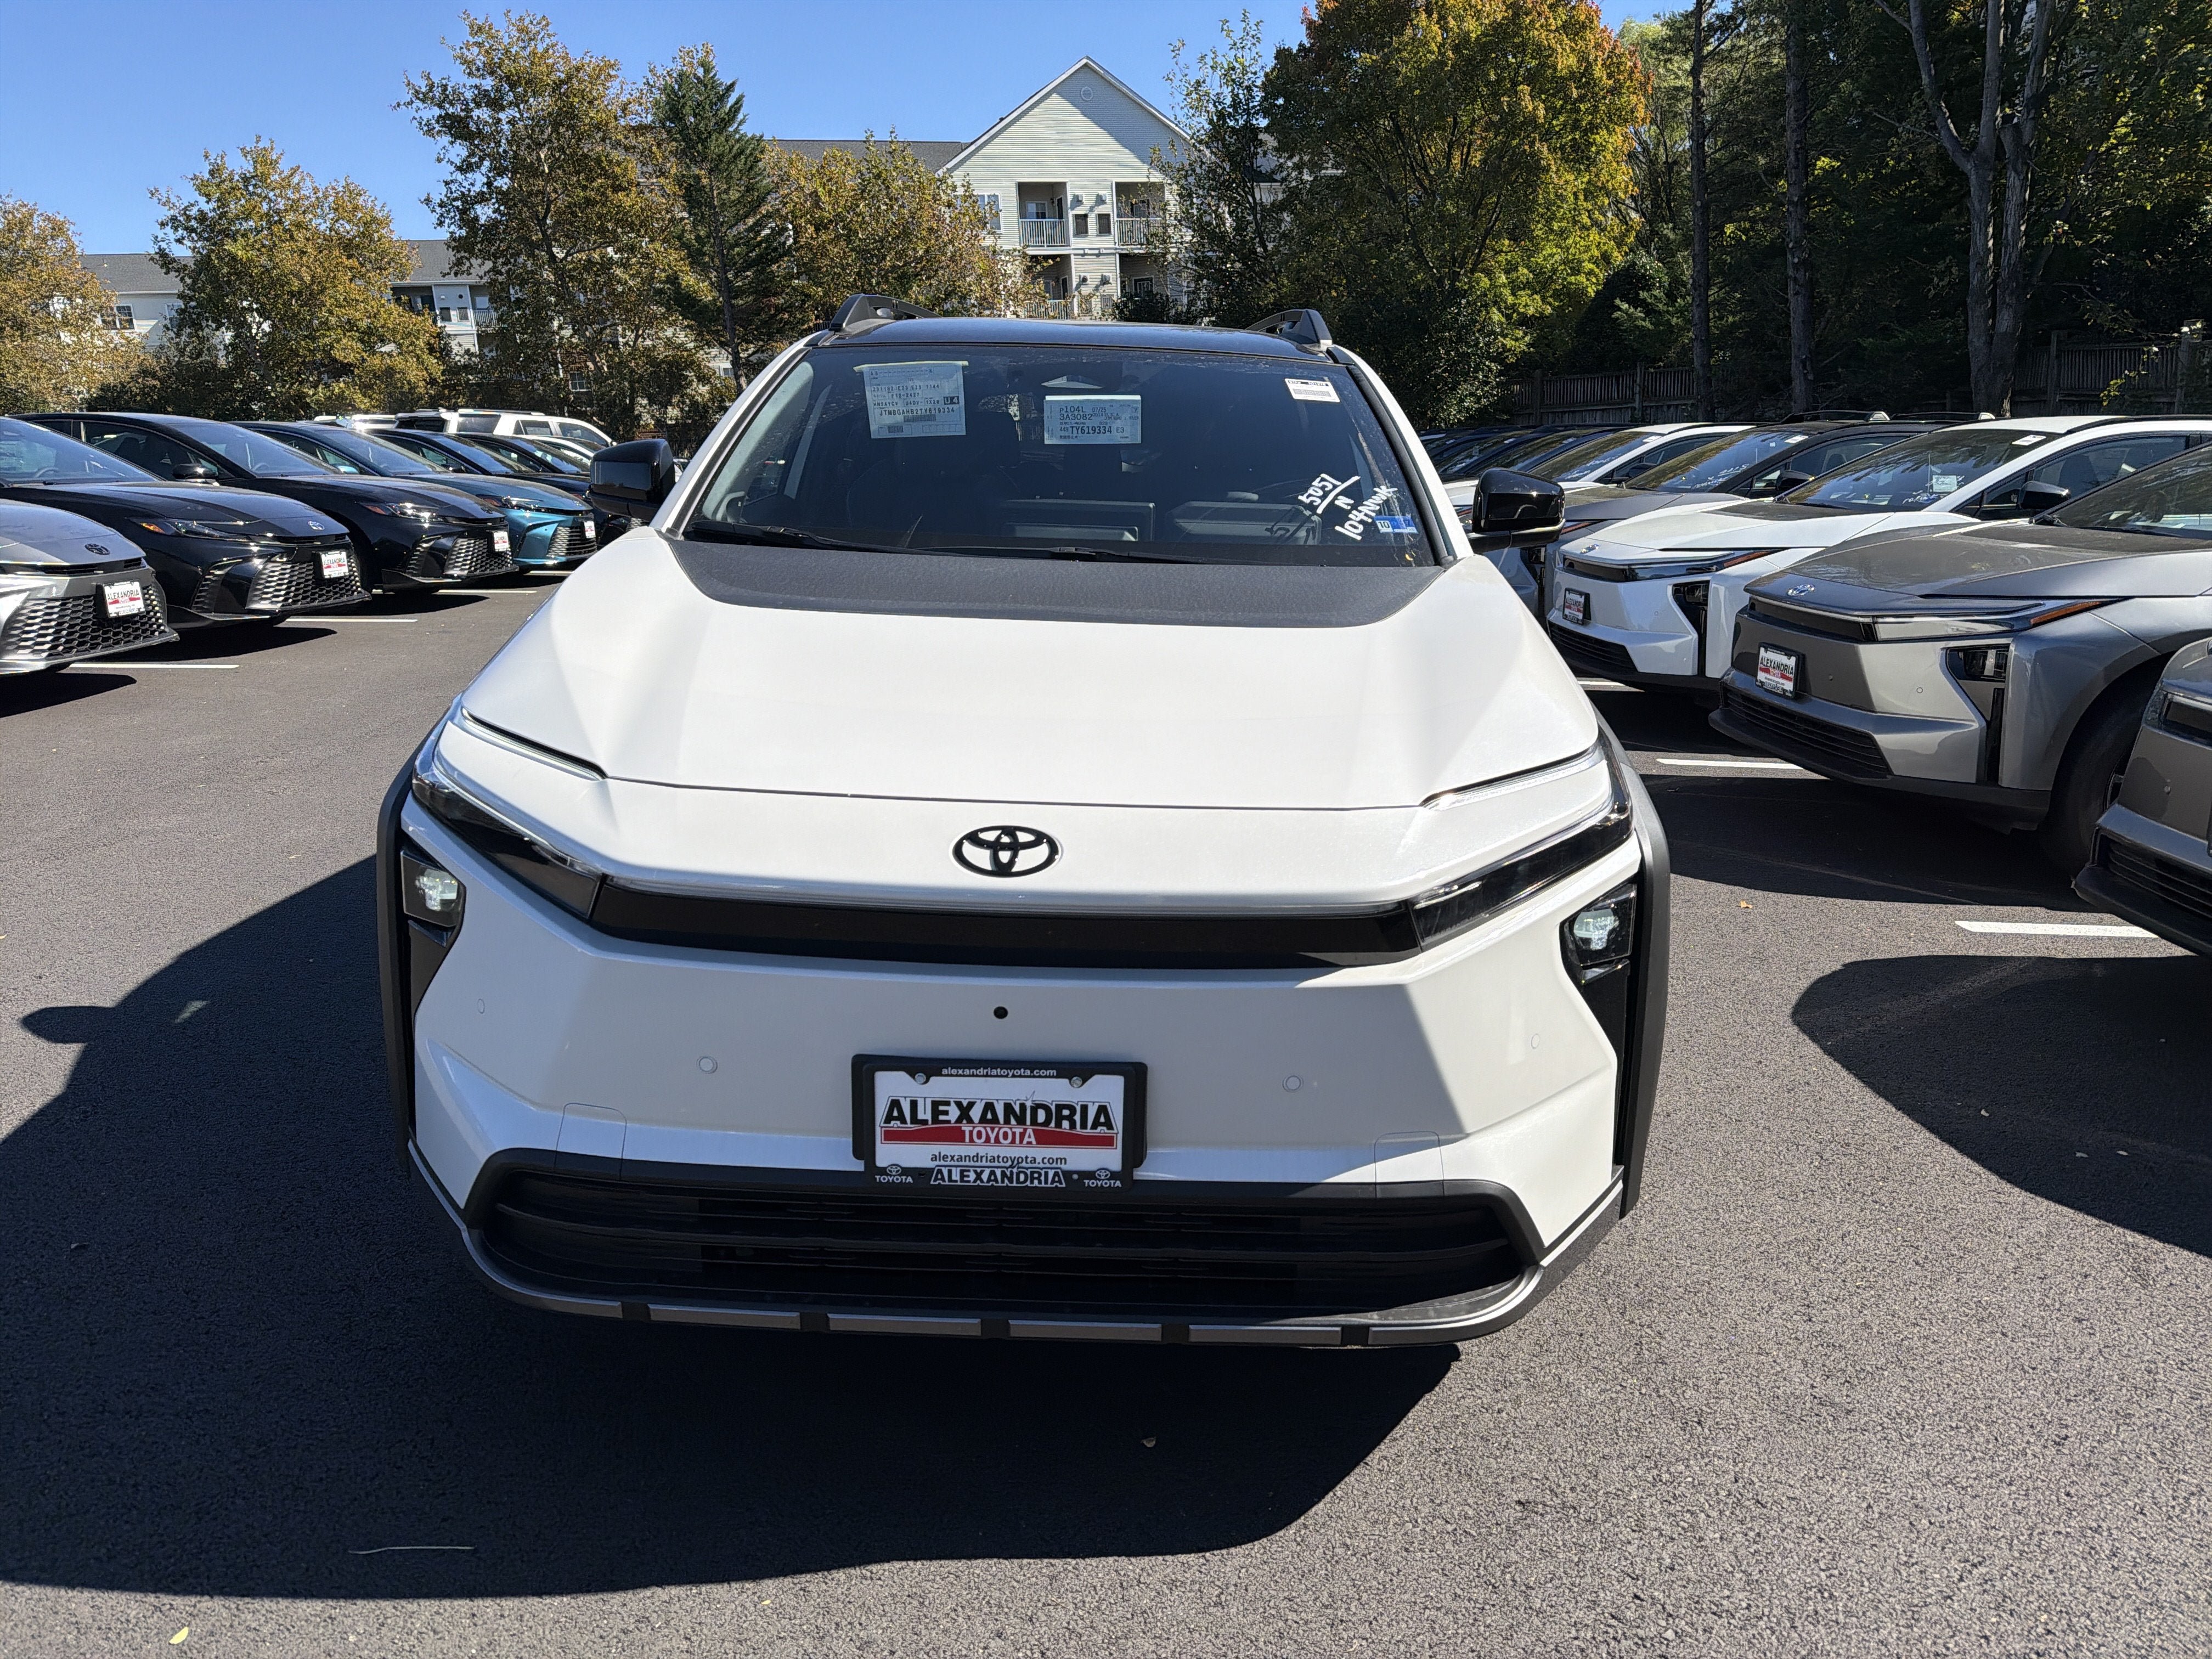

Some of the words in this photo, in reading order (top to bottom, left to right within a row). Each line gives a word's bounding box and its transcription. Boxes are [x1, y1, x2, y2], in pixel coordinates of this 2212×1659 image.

[1070, 426, 1112, 434] TY619334
[1760, 656, 1793, 676] ALEXANDRIA
[941, 1067, 1057, 1077] alexandriatoyota.com
[883, 1098, 1115, 1130] ALEXANDRIA
[961, 1126, 1036, 1144] TOYOTA
[930, 1152, 1067, 1167] alexandriatoyota.com
[874, 1175, 913, 1183] TOYOTA
[930, 1166, 1066, 1187] ALEXANDRIA
[1084, 1179, 1122, 1188] TOYOTA
